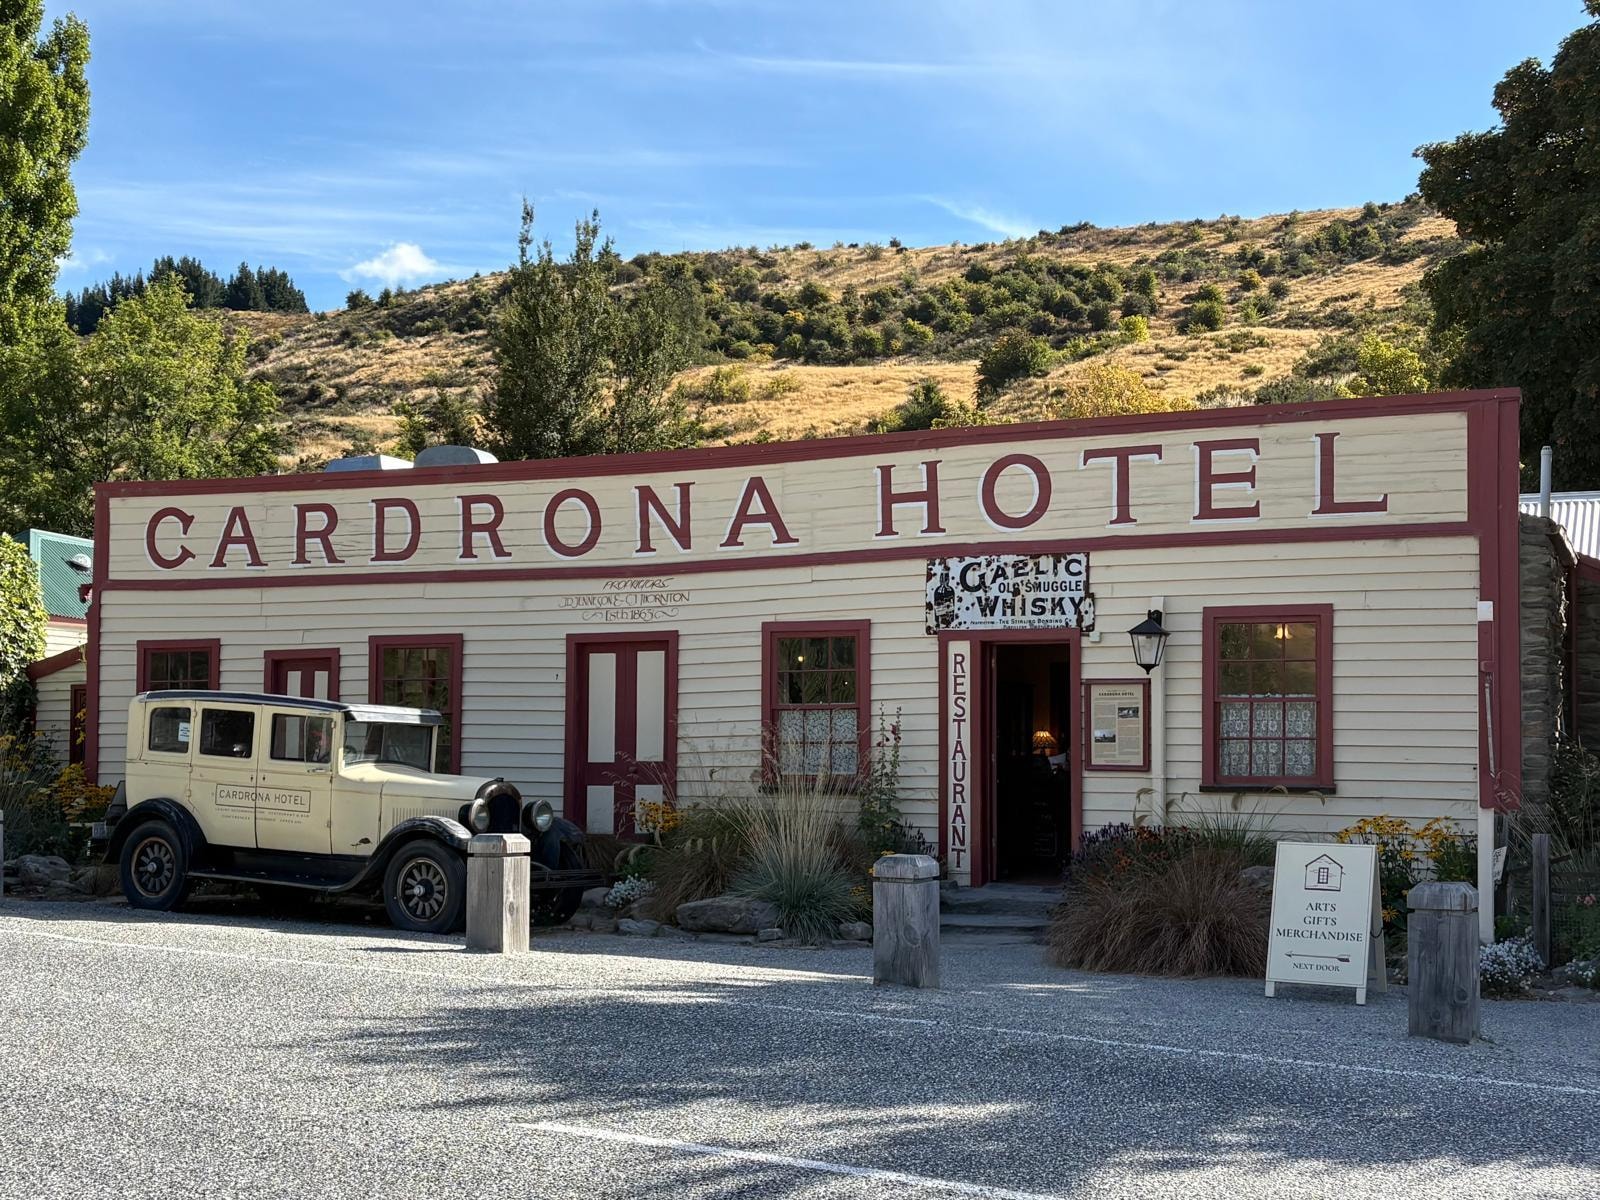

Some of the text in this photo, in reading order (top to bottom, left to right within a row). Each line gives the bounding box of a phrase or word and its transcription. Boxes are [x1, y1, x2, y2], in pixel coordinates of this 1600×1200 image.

[145, 432, 1388, 570] CARDRONA HOTEL
[960, 558, 1083, 593] GAELIC
[976, 596, 1084, 617] WHISKY
[951, 653, 967, 868] RESTAURANT
[219, 789, 306, 806] CARDRONA HOTEL
[1305, 902, 1337, 912] ARTS
[1303, 915, 1337, 927] GIFTS
[1276, 927, 1363, 942] MERCHANDISE
[1292, 962, 1341, 972] NEXT DOOR
